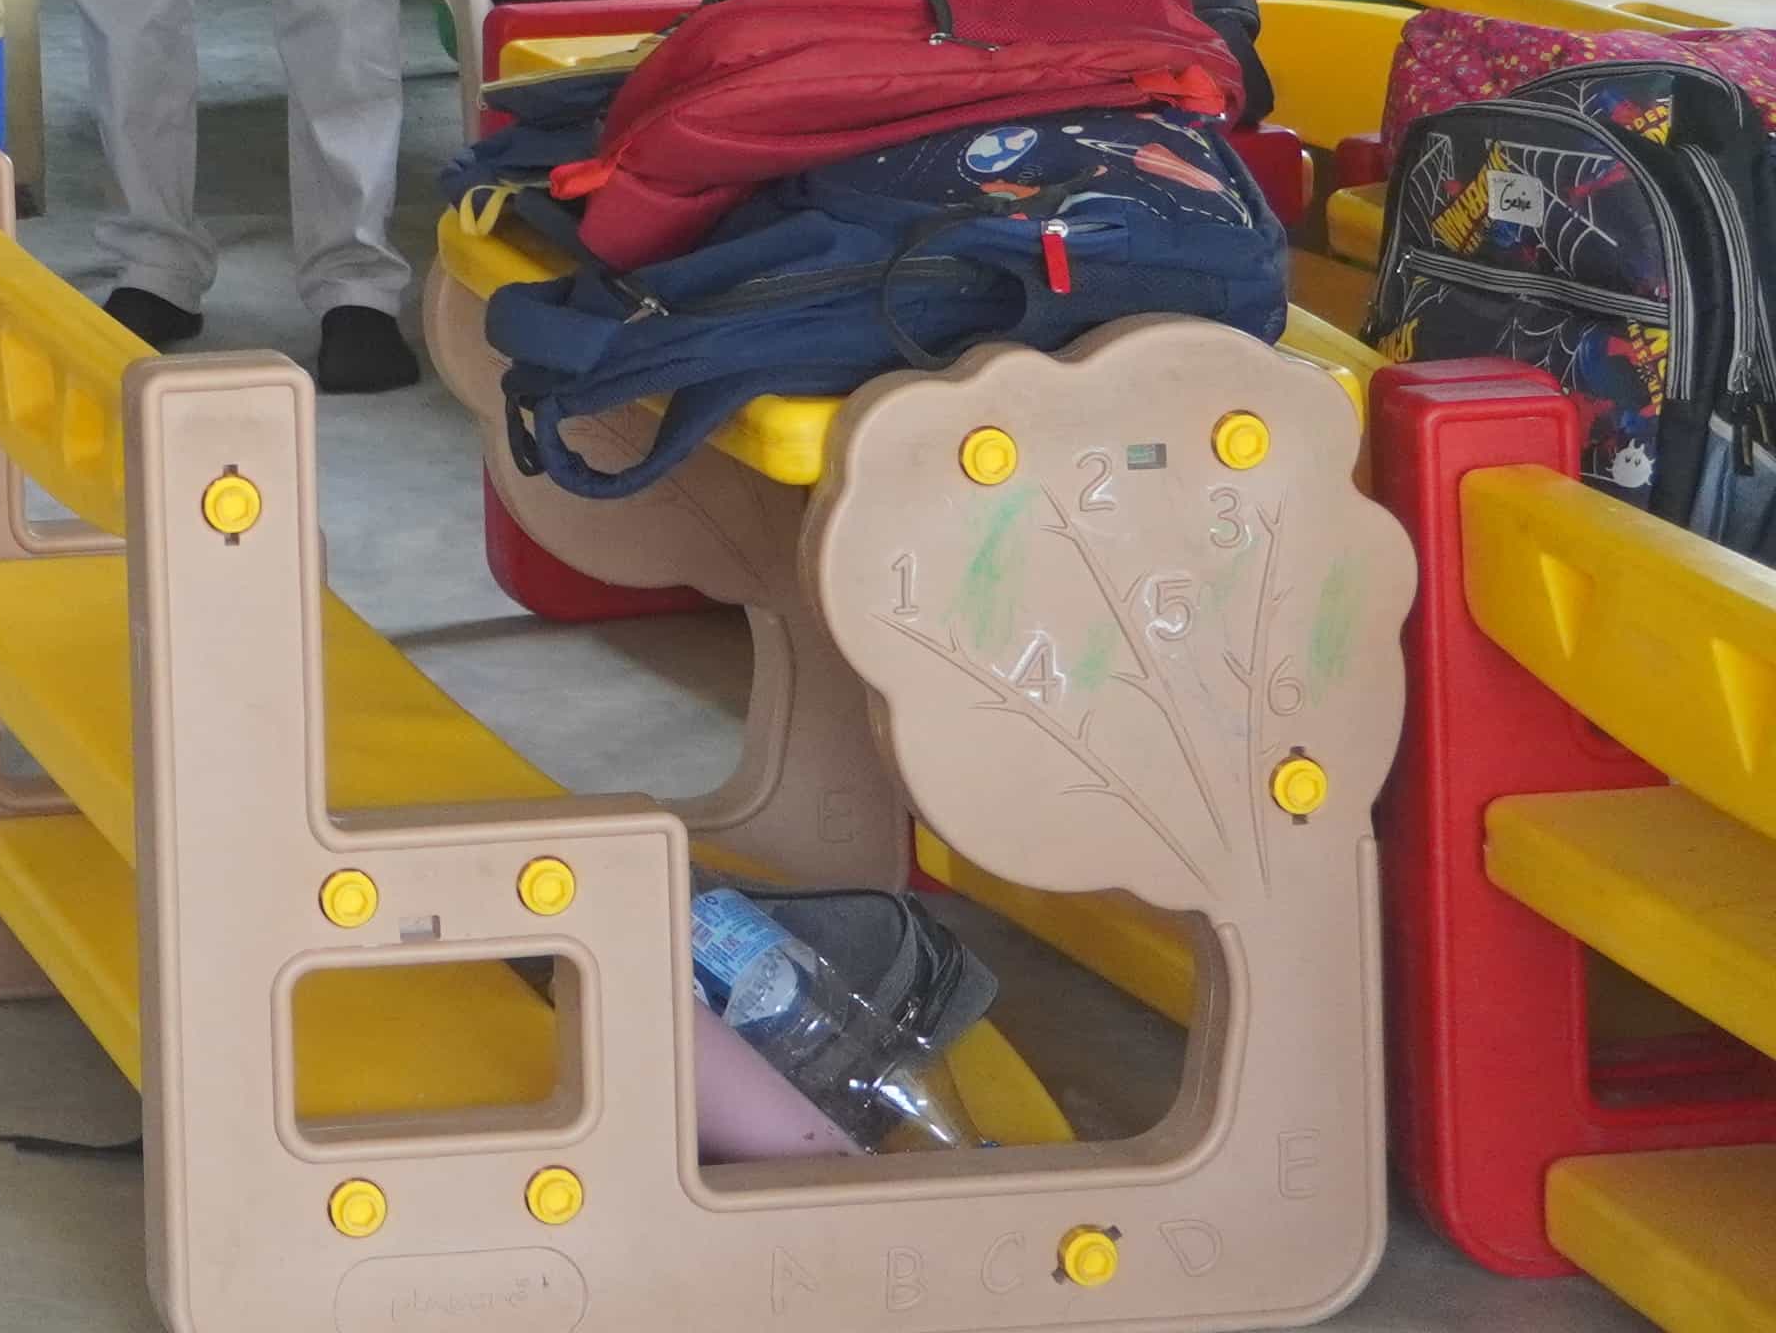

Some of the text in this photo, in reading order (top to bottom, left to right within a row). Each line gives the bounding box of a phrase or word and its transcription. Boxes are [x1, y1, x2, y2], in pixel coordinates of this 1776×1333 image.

[1076, 450, 1248, 550] 2 3
[889, 552, 1194, 642] 1 5
[1266, 653, 1304, 717] 6
